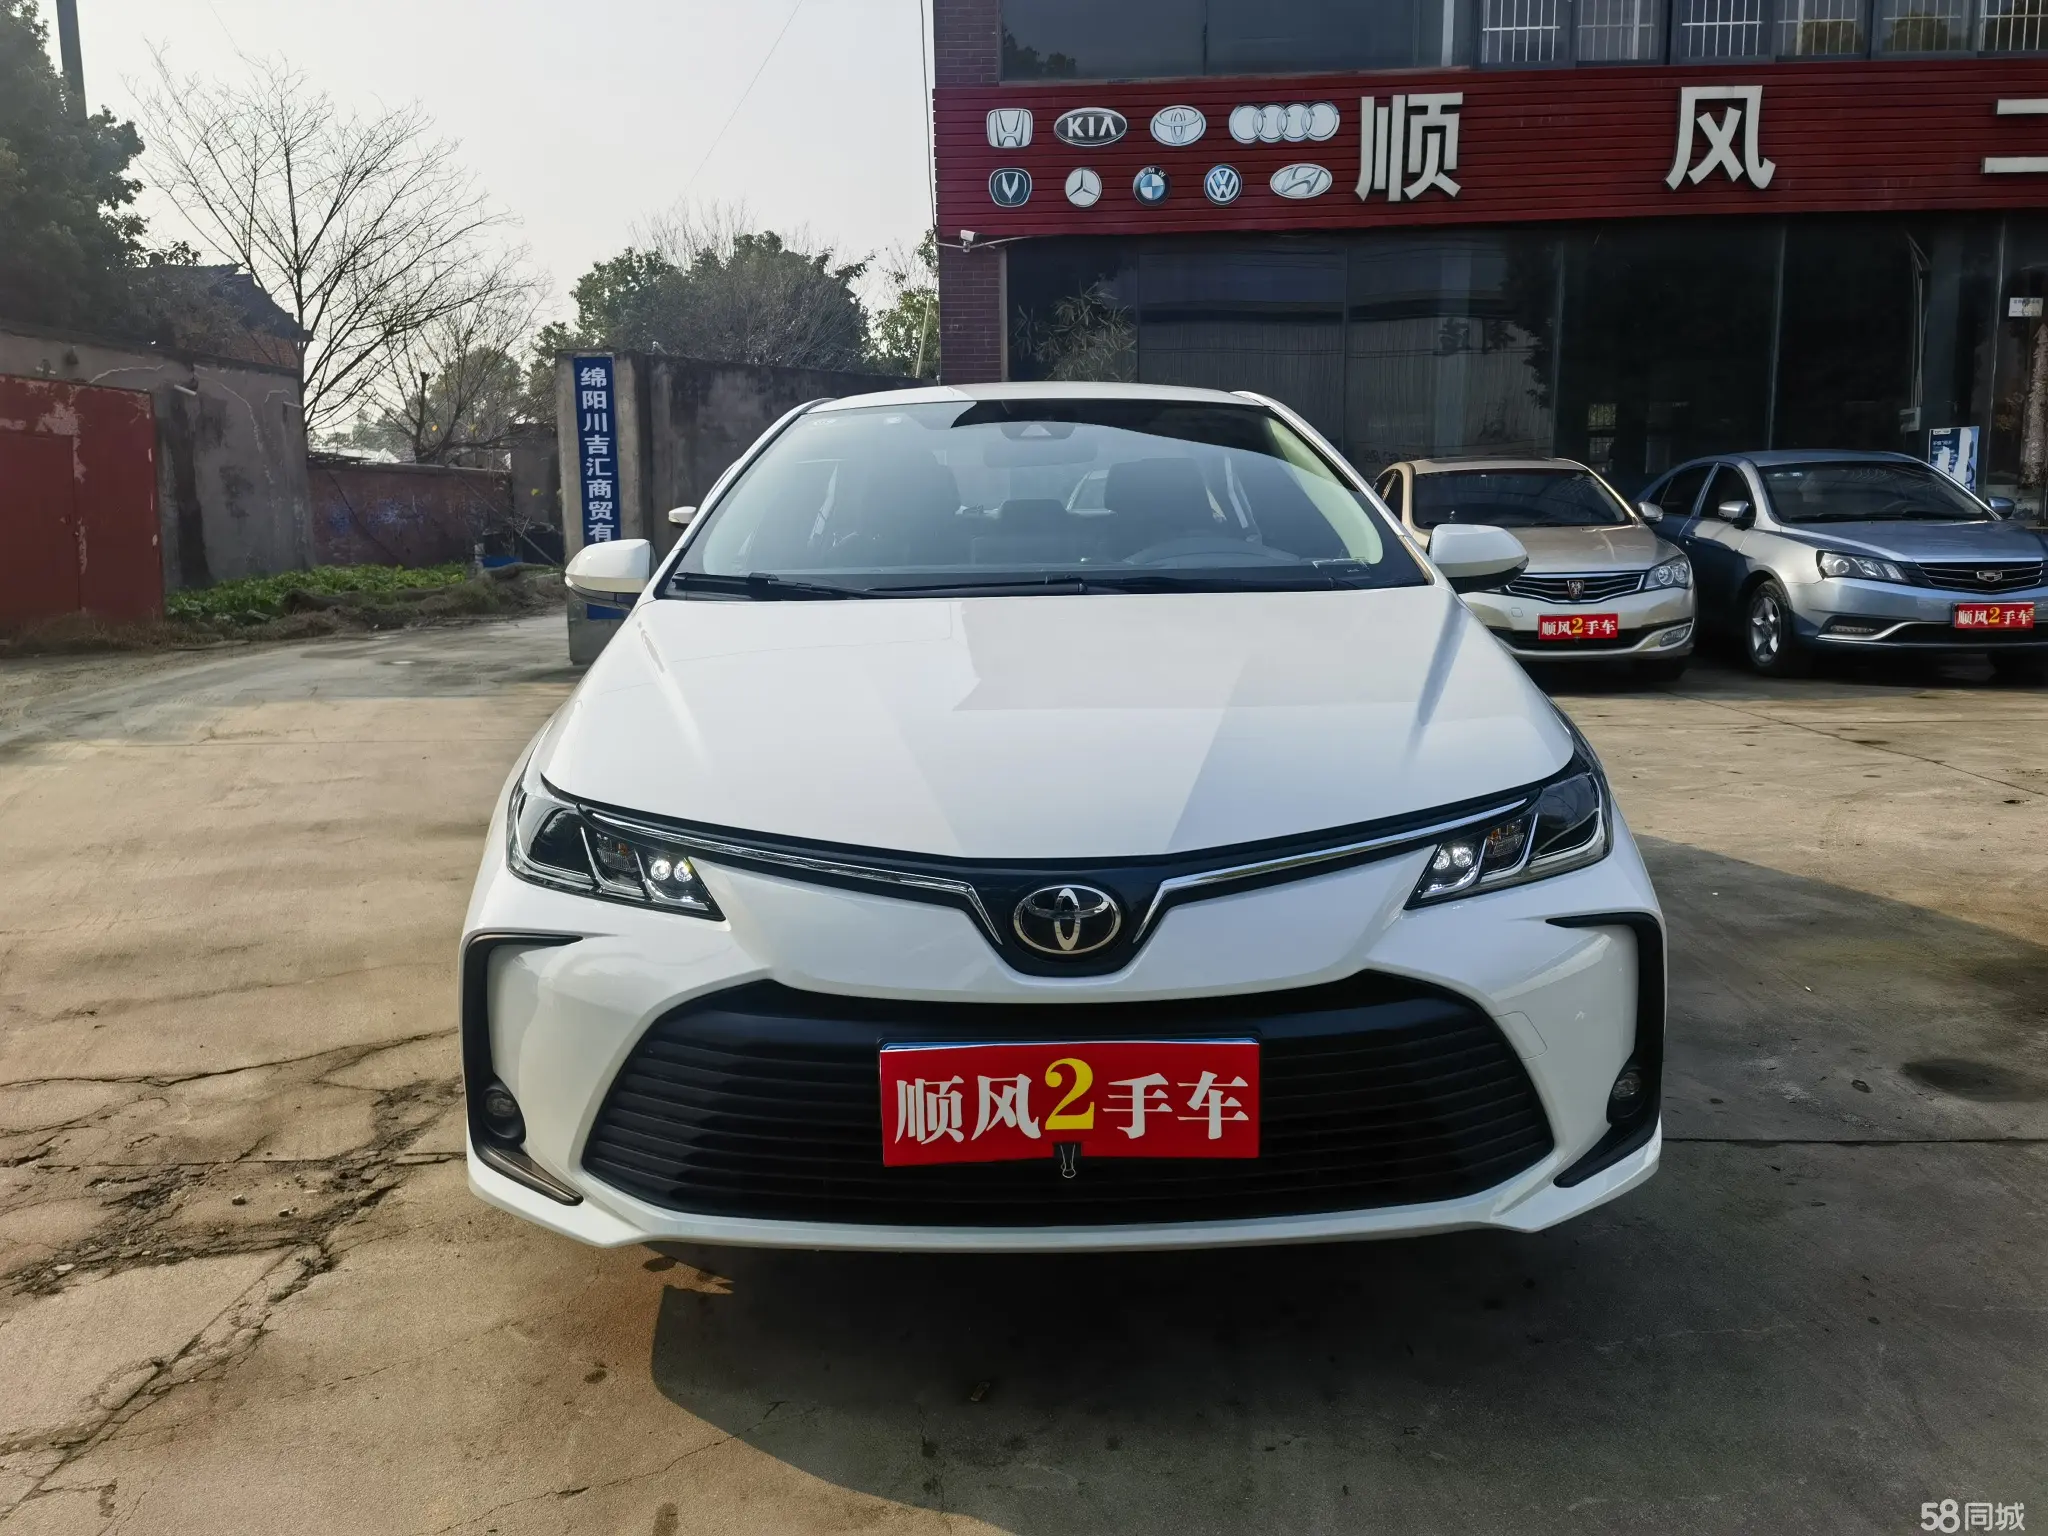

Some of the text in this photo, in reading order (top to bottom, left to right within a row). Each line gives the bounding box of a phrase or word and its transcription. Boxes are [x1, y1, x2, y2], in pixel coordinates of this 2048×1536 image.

[1067, 116, 1117, 138] KIA
[580, 366, 615, 543] 绵阳川吉汇商贸有
[1541, 616, 1617, 637] 顺风2手车
[1957, 606, 2033, 626] 顺风2手车
[895, 1057, 1249, 1145] 顺风2手车
